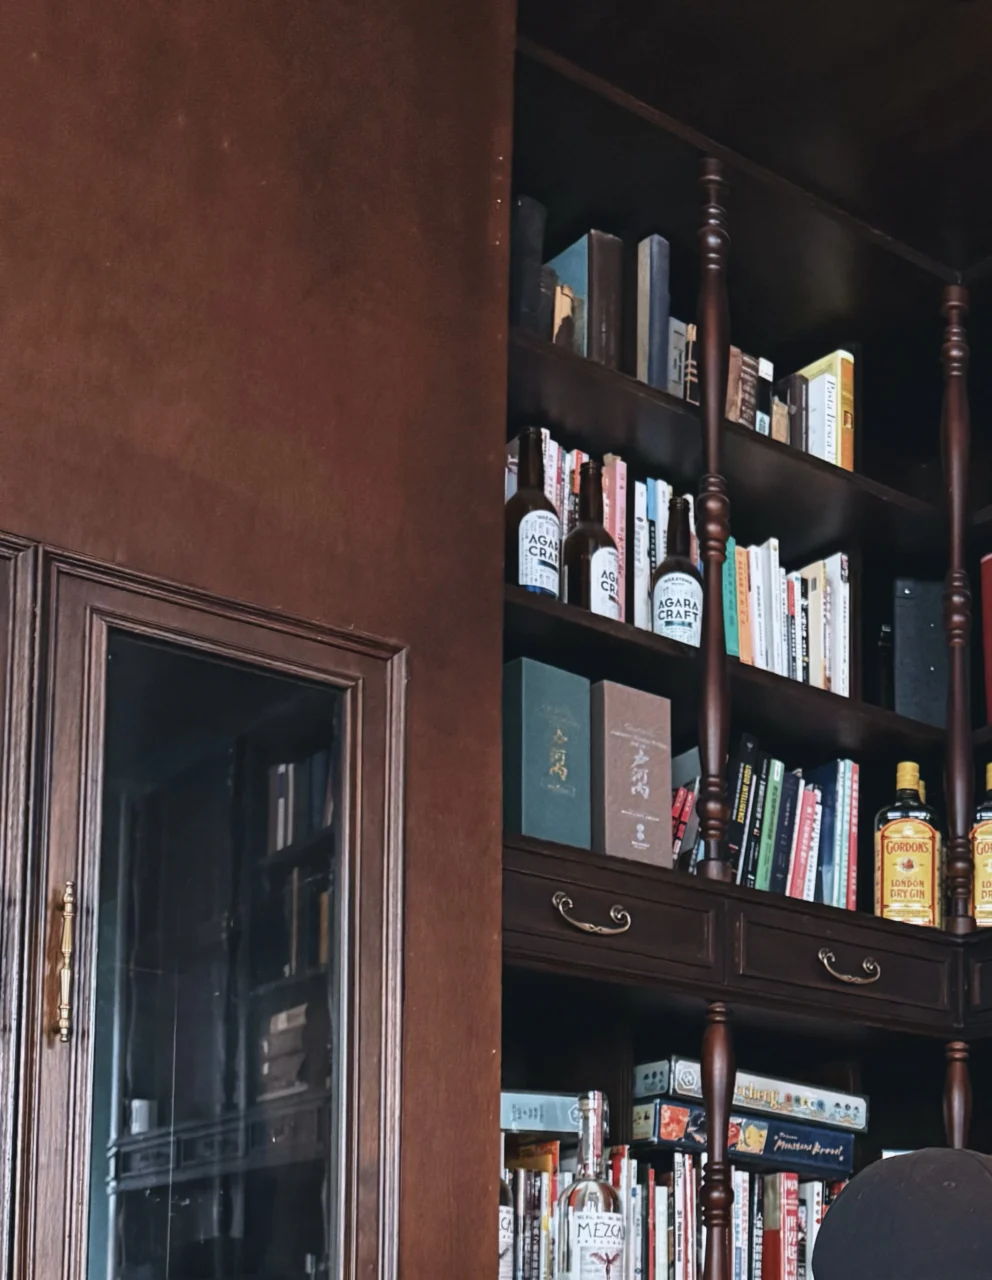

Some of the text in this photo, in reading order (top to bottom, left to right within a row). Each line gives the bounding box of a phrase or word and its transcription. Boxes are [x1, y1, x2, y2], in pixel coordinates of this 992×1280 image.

[658, 598, 699, 612] AGARA
[657, 609, 700, 623] CRAFT
[737, 785, 751, 824] INTELLIGENCE
[891, 880, 924, 888] LONDON
[890, 889, 925, 899] DRY GIN
